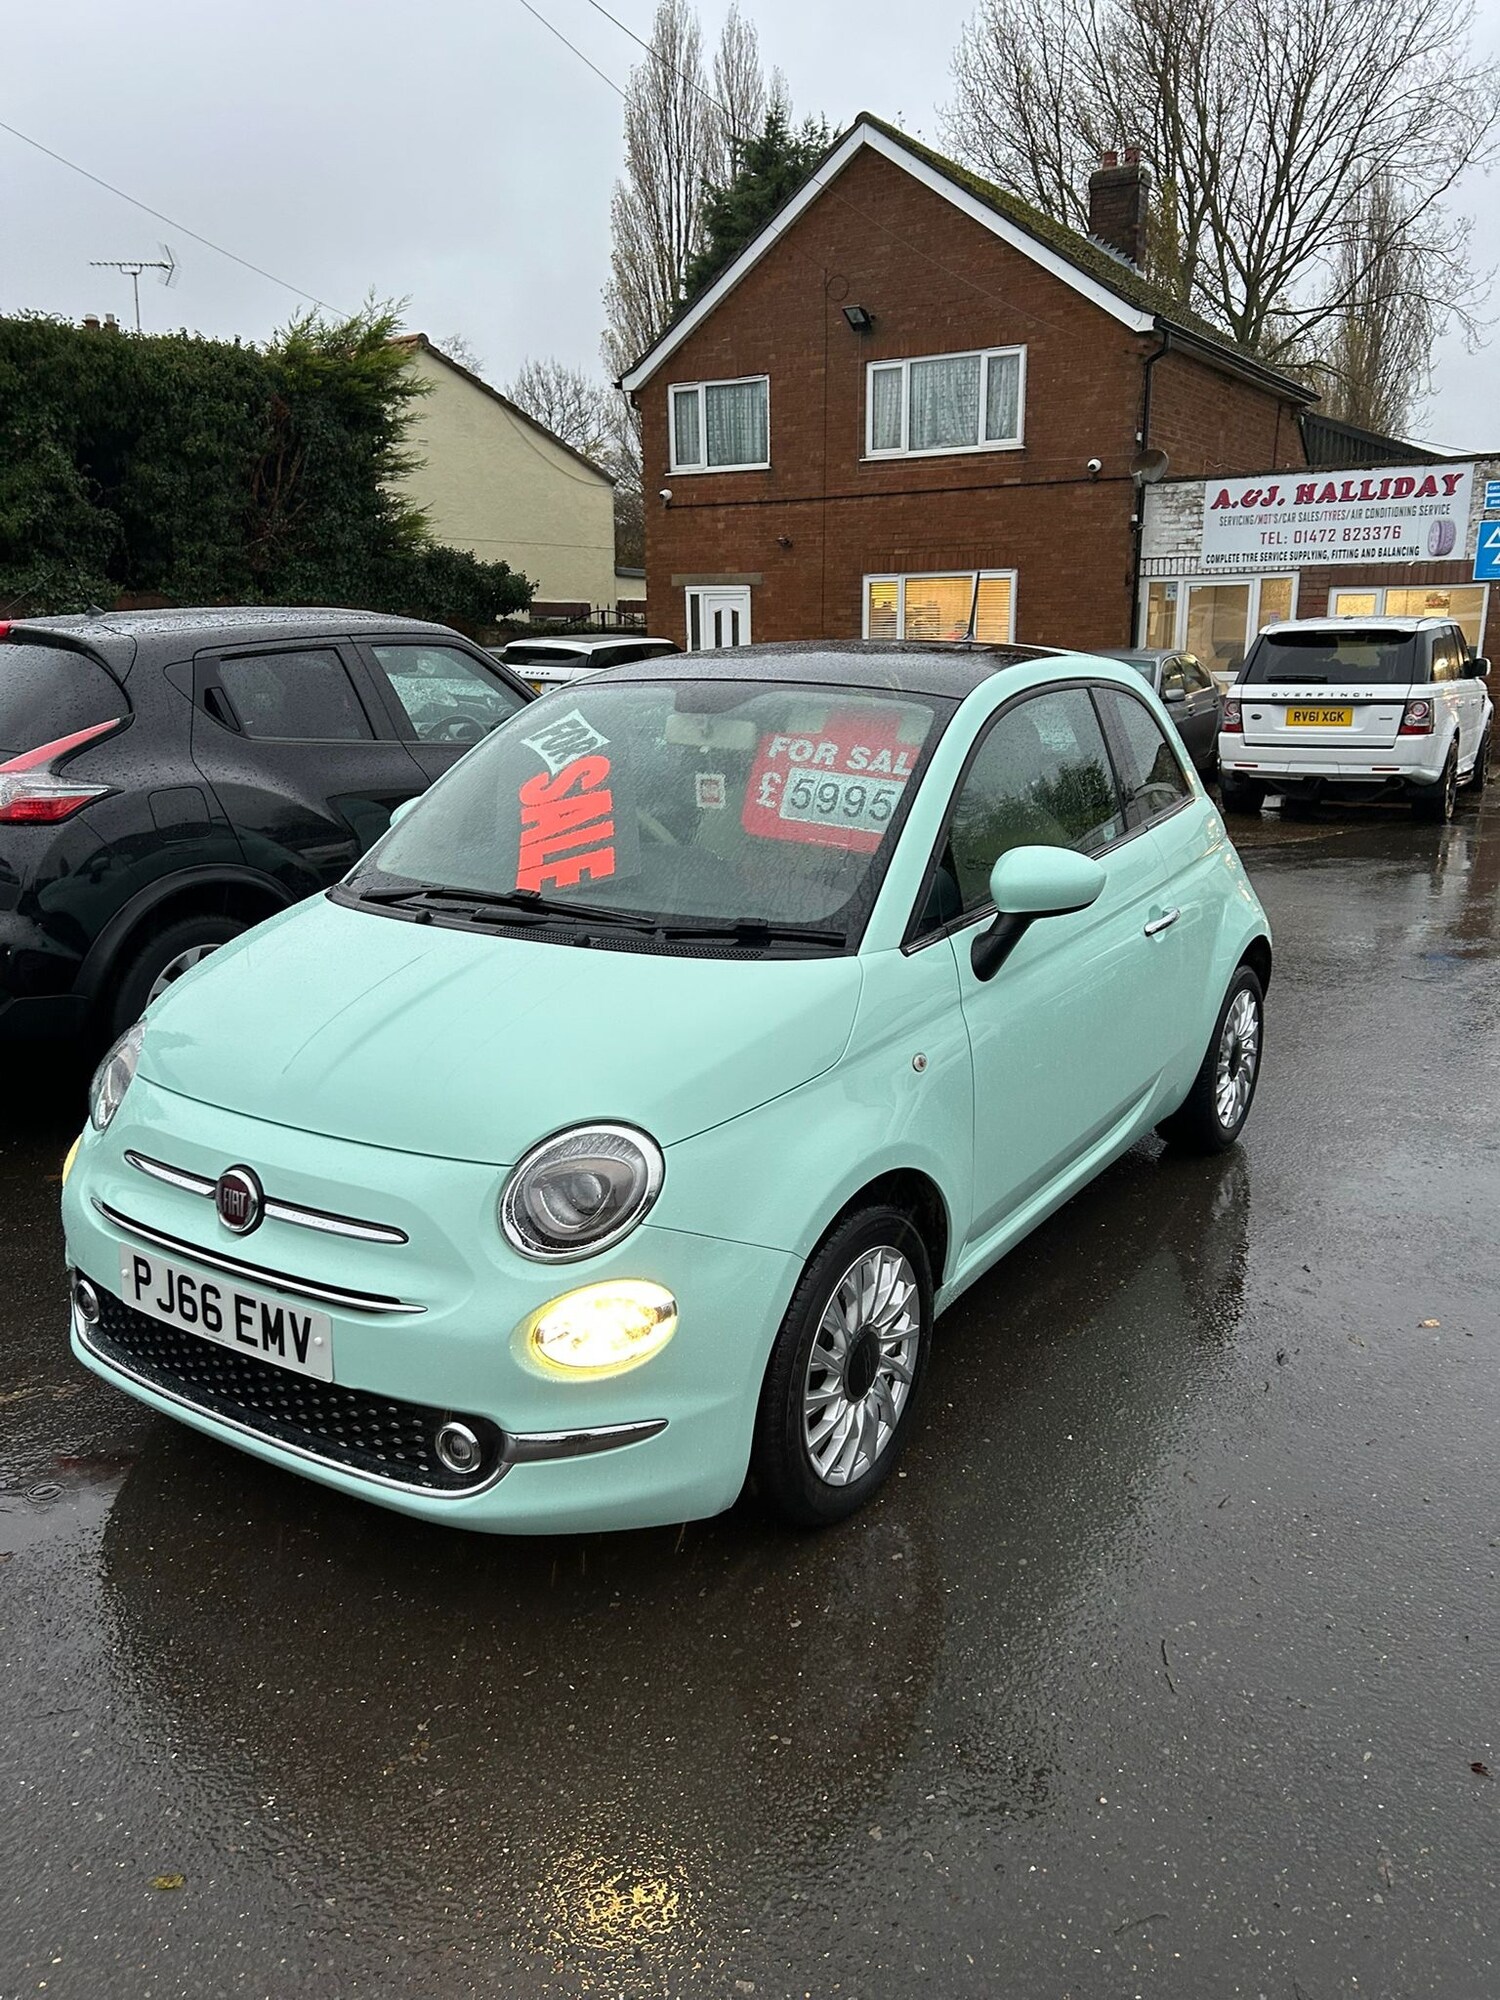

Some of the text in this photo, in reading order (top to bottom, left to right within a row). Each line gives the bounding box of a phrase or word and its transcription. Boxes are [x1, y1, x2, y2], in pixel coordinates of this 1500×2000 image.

[1294, 473, 1464, 505] HALLIDAY
[1364, 505, 1417, 519] CONDITIONING
[1419, 503, 1451, 516] SERVICE
[1260, 525, 1402, 545] TEL: 01472 823376
[1206, 545, 1420, 564] COMPLETE TYRE SERVICE SUPPLYING, FITTING AND BALANCING
[1293, 711, 1345, 722] RV61 XGK
[768, 735, 912, 776] FOR SAL
[516, 755, 616, 893] SALE
[223, 1187, 247, 1217] FIAT
[133, 1254, 312, 1364] PJ66 EMV
